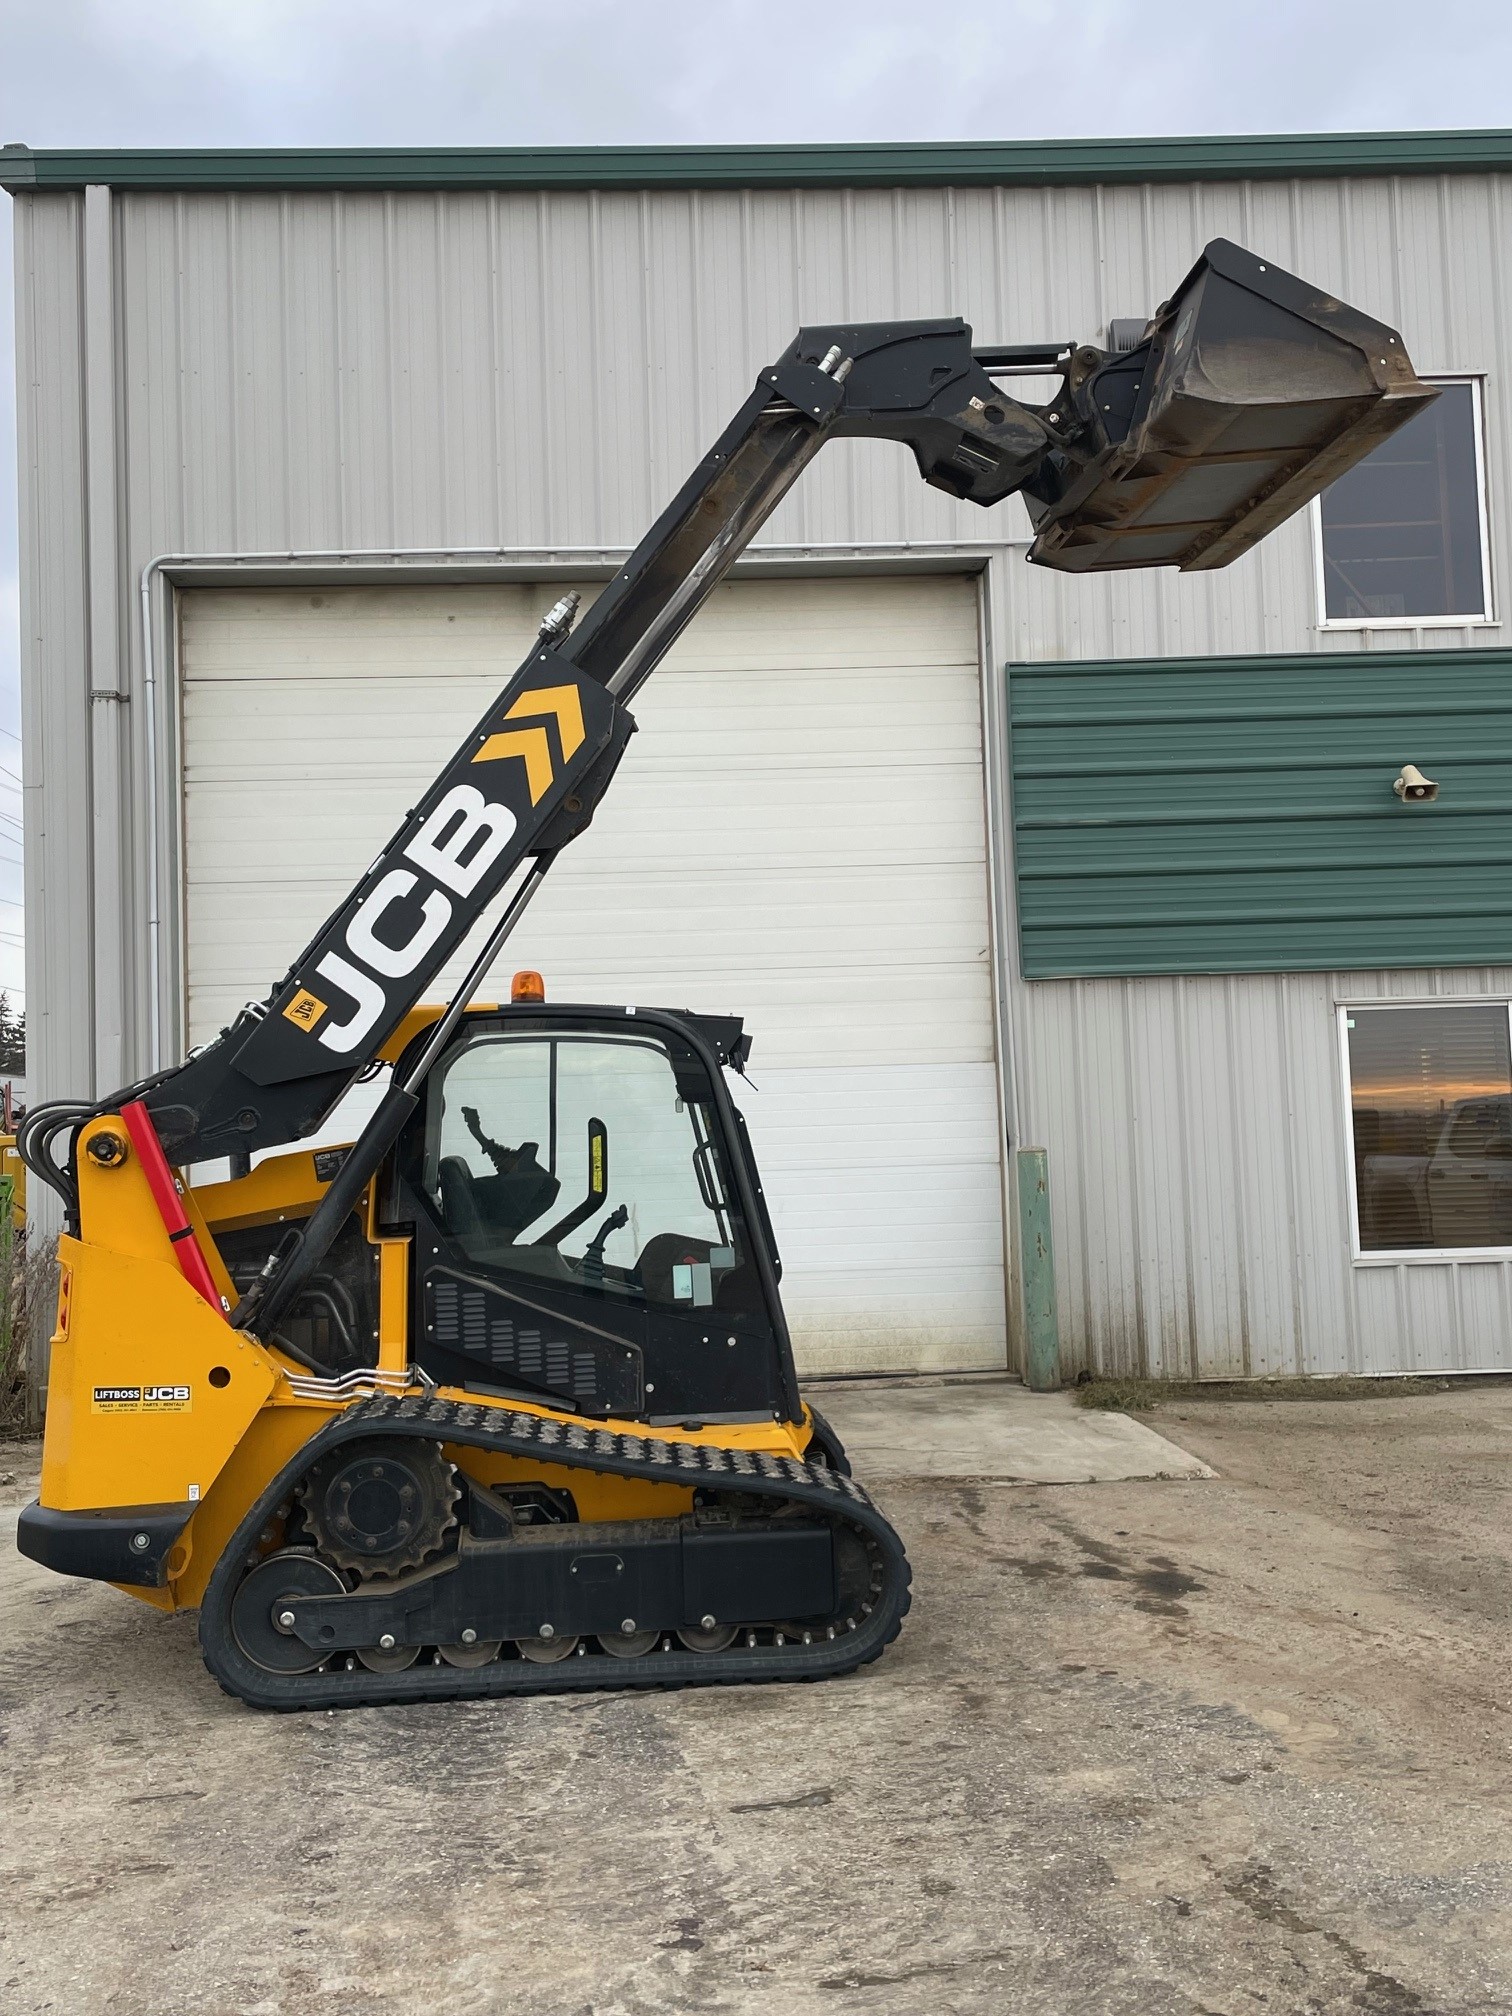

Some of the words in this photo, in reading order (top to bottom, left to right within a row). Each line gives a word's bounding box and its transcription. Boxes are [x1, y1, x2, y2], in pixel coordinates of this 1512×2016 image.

[315, 784, 517, 1053] JCB
[294, 1000, 314, 1019] JCB
[95, 1390, 140, 1399] LIFTBOSS
[144, 1387, 189, 1400] JCB
